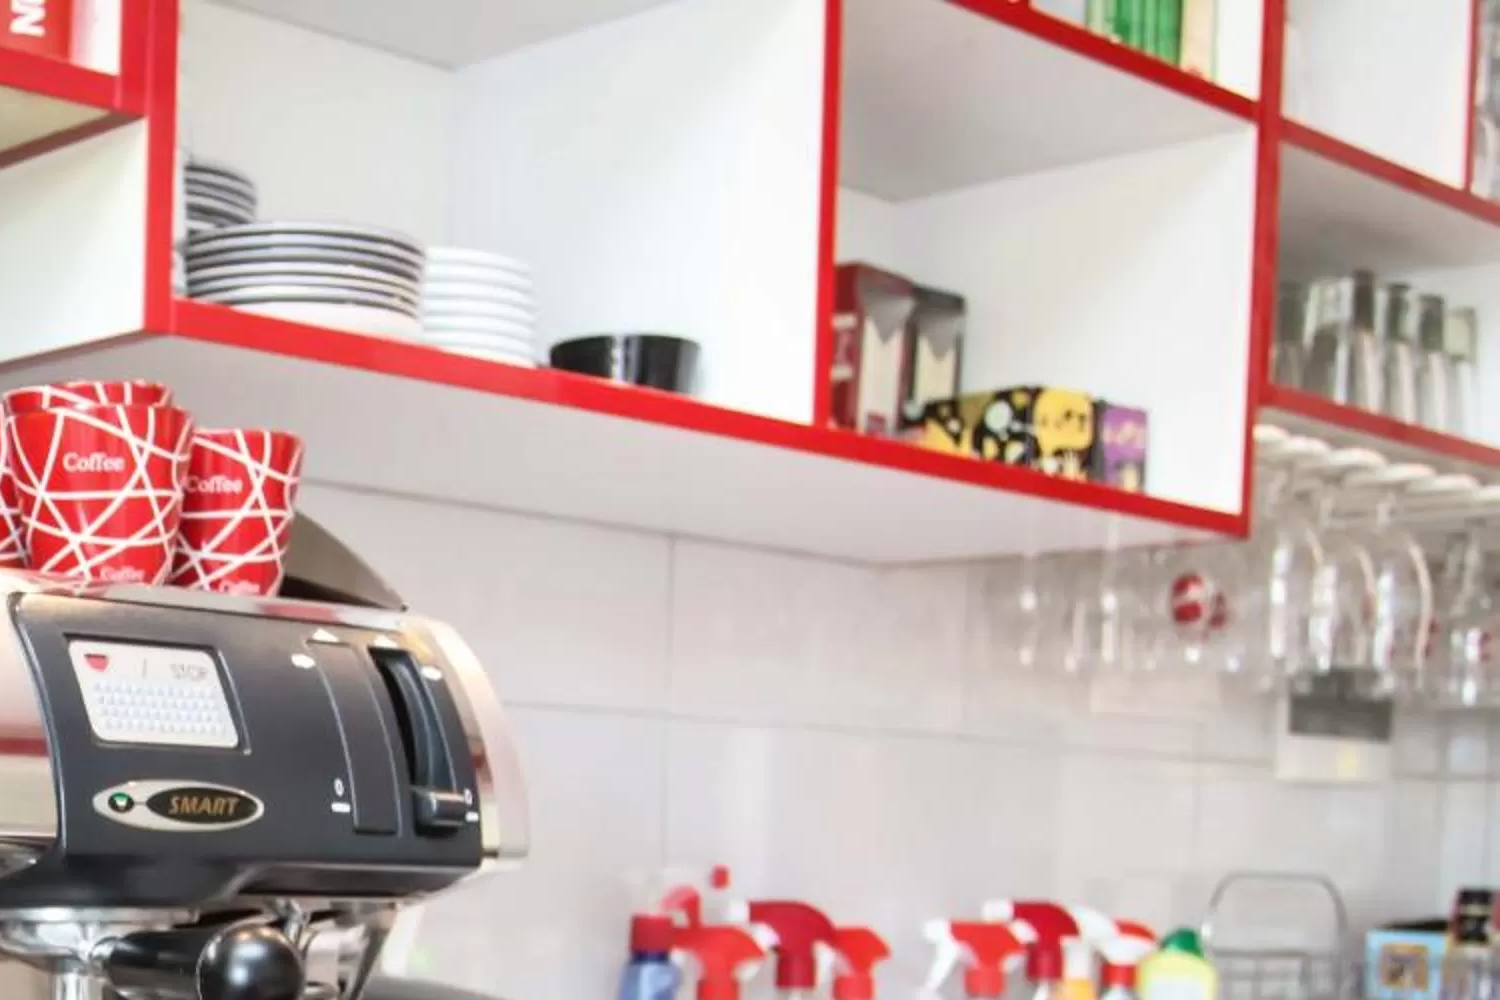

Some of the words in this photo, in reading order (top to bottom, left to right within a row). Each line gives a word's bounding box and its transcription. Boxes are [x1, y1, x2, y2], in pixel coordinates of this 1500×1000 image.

[63, 452, 126, 472] Coffee
[186, 475, 243, 493] Coffee
[168, 795, 240, 816] SMART
